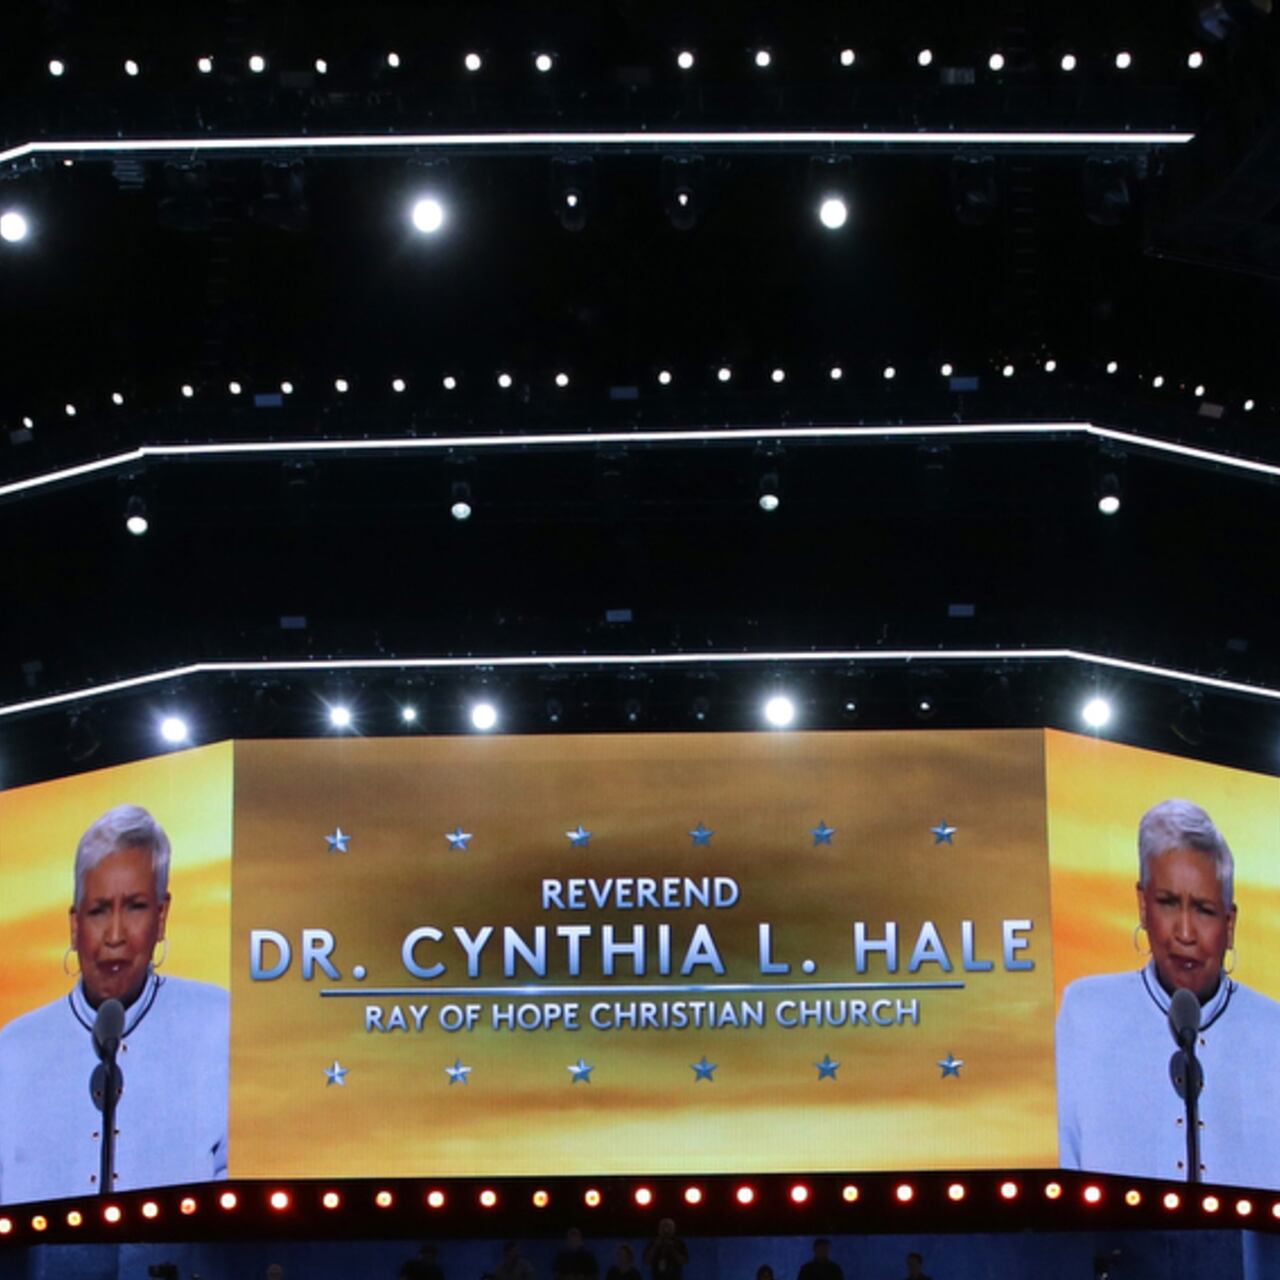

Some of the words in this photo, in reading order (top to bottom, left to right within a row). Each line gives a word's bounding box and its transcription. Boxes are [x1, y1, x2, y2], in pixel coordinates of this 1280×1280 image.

[541, 877, 740, 909] REVEREND
[249, 928, 368, 981] DR.
[401, 923, 726, 979] CYNTHIA
[758, 922, 817, 975] L.
[853, 919, 1036, 973] HALE
[364, 1005, 429, 1033] RAY
[438, 1004, 481, 1031] OF
[491, 1002, 580, 1030] HOPE
[590, 1000, 765, 1030] CHRISTIAN
[775, 998, 919, 1028] CHURCH
